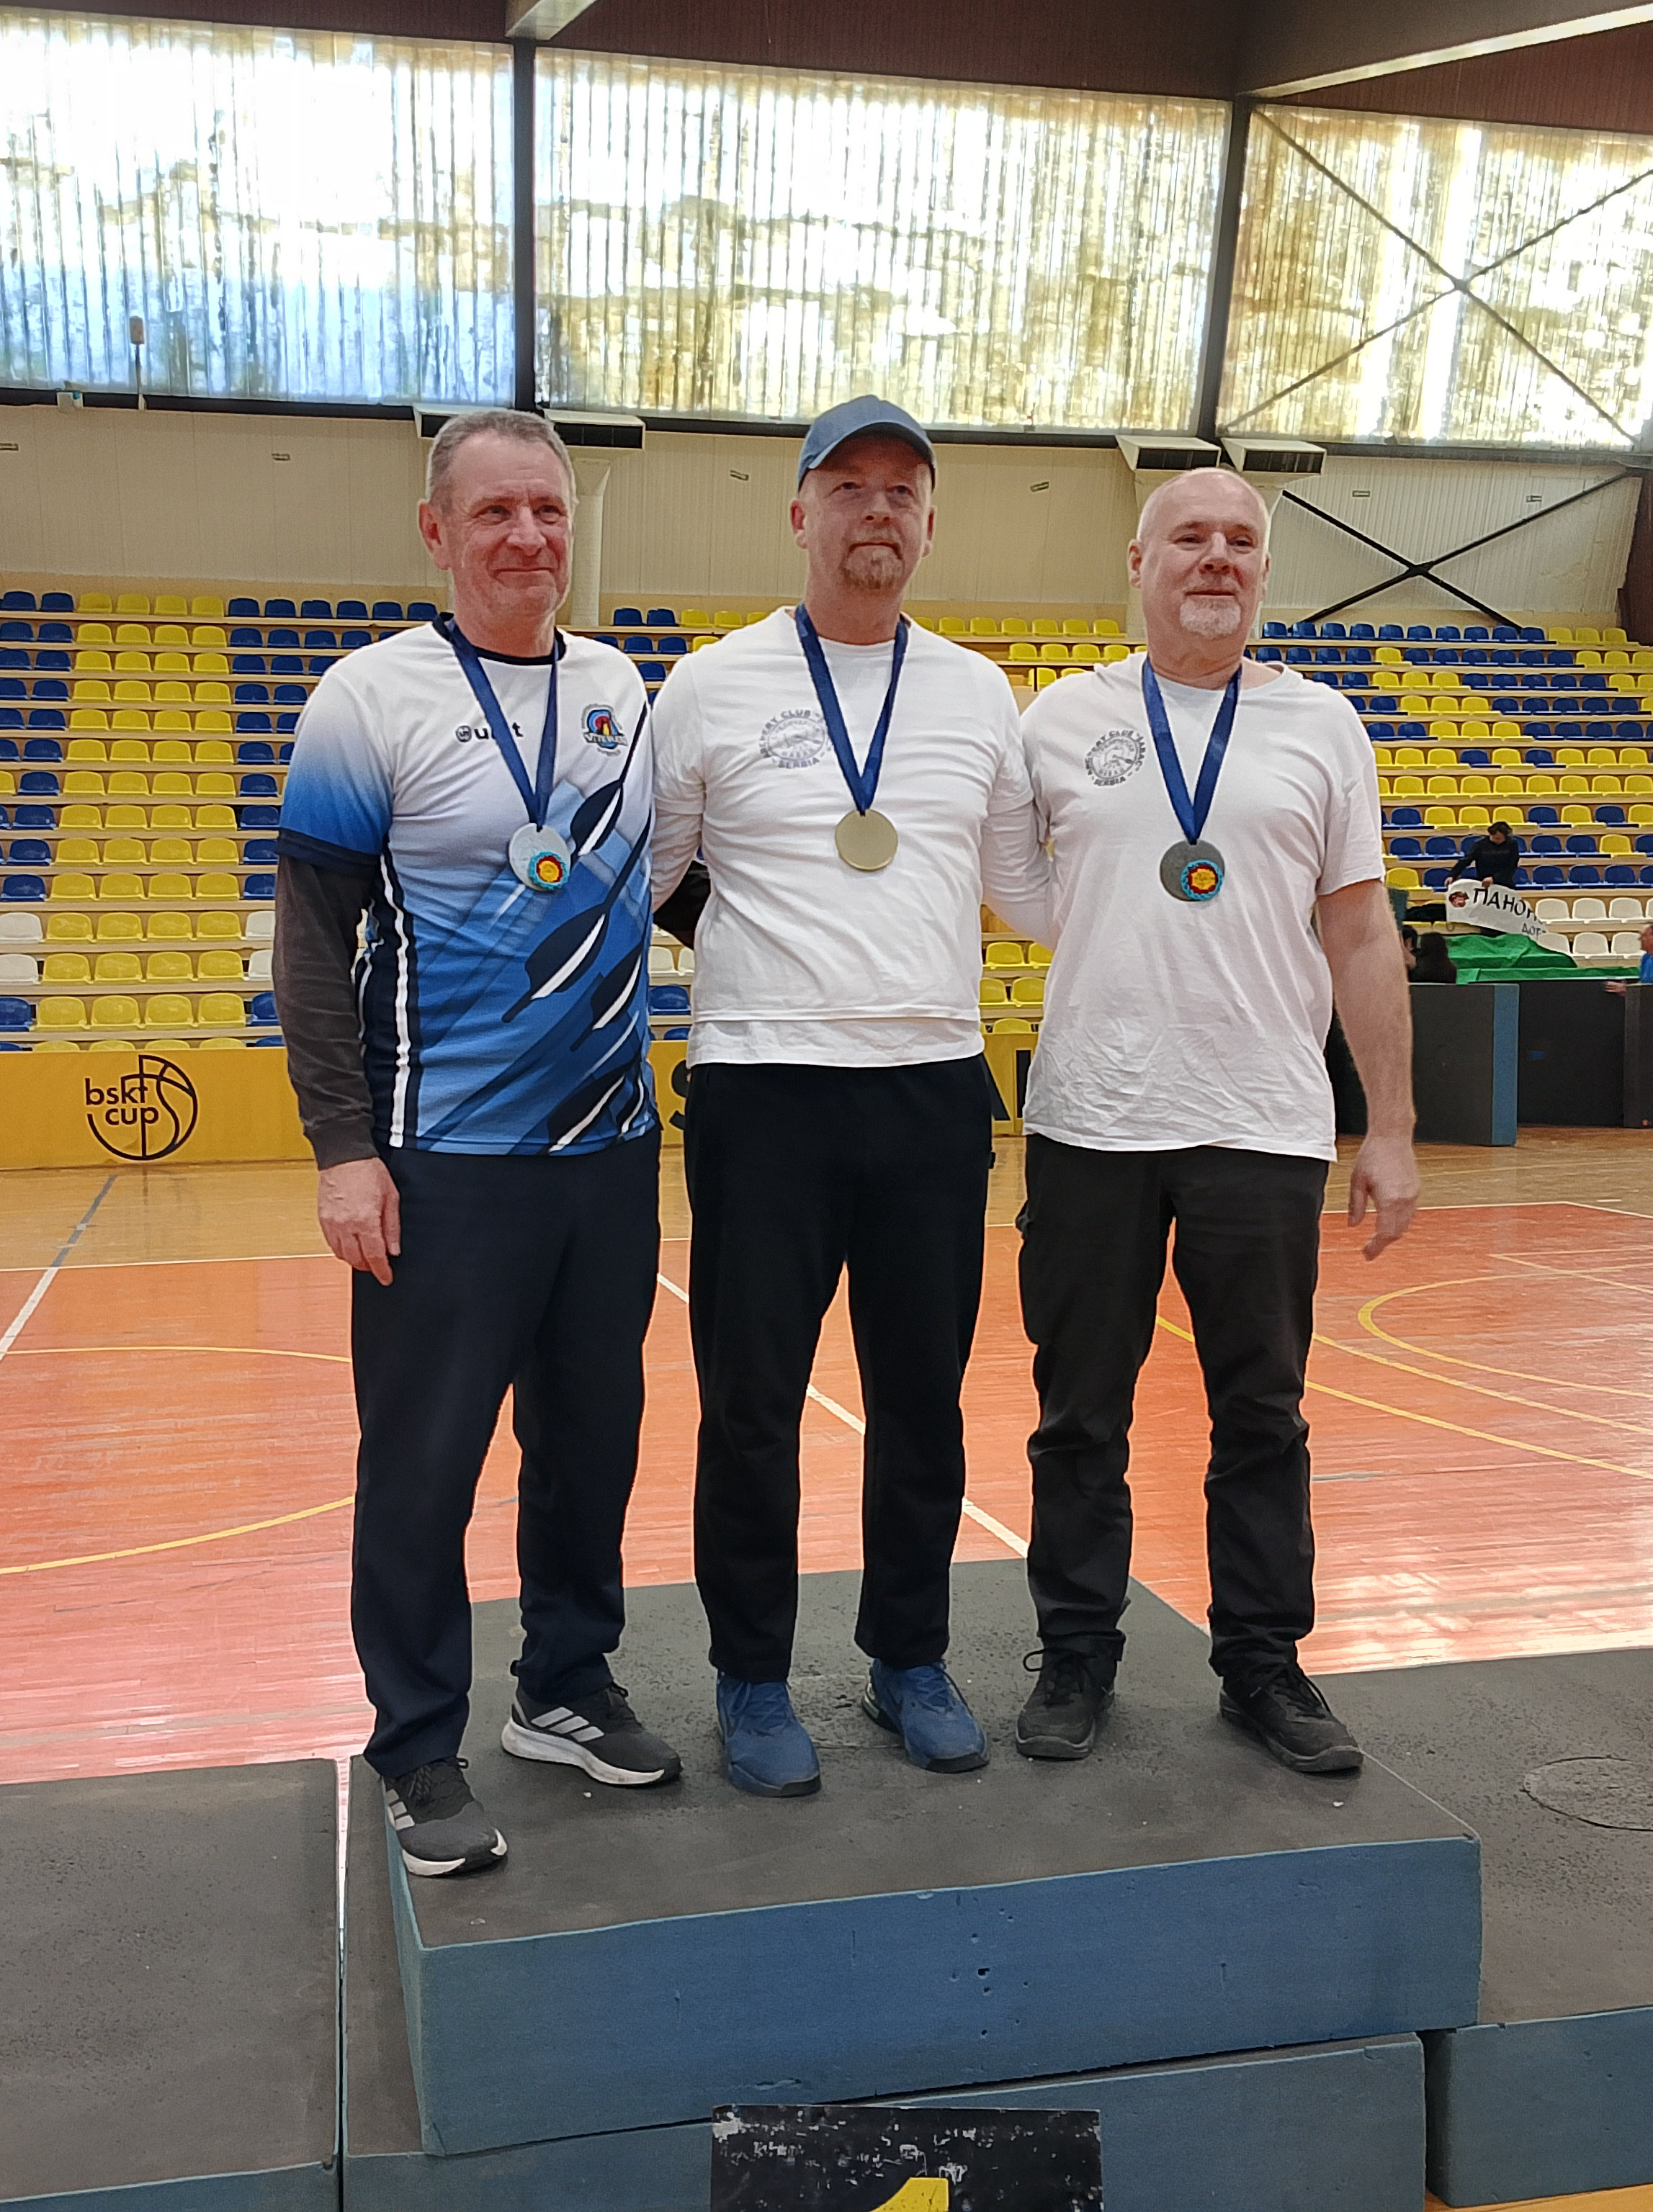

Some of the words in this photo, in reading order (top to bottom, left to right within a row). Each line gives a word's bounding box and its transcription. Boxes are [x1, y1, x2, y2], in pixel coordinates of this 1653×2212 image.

[780, 709, 812, 718] CLUB
[84, 1077, 148, 1106] bskt
[105, 1106, 159, 1128] cup
